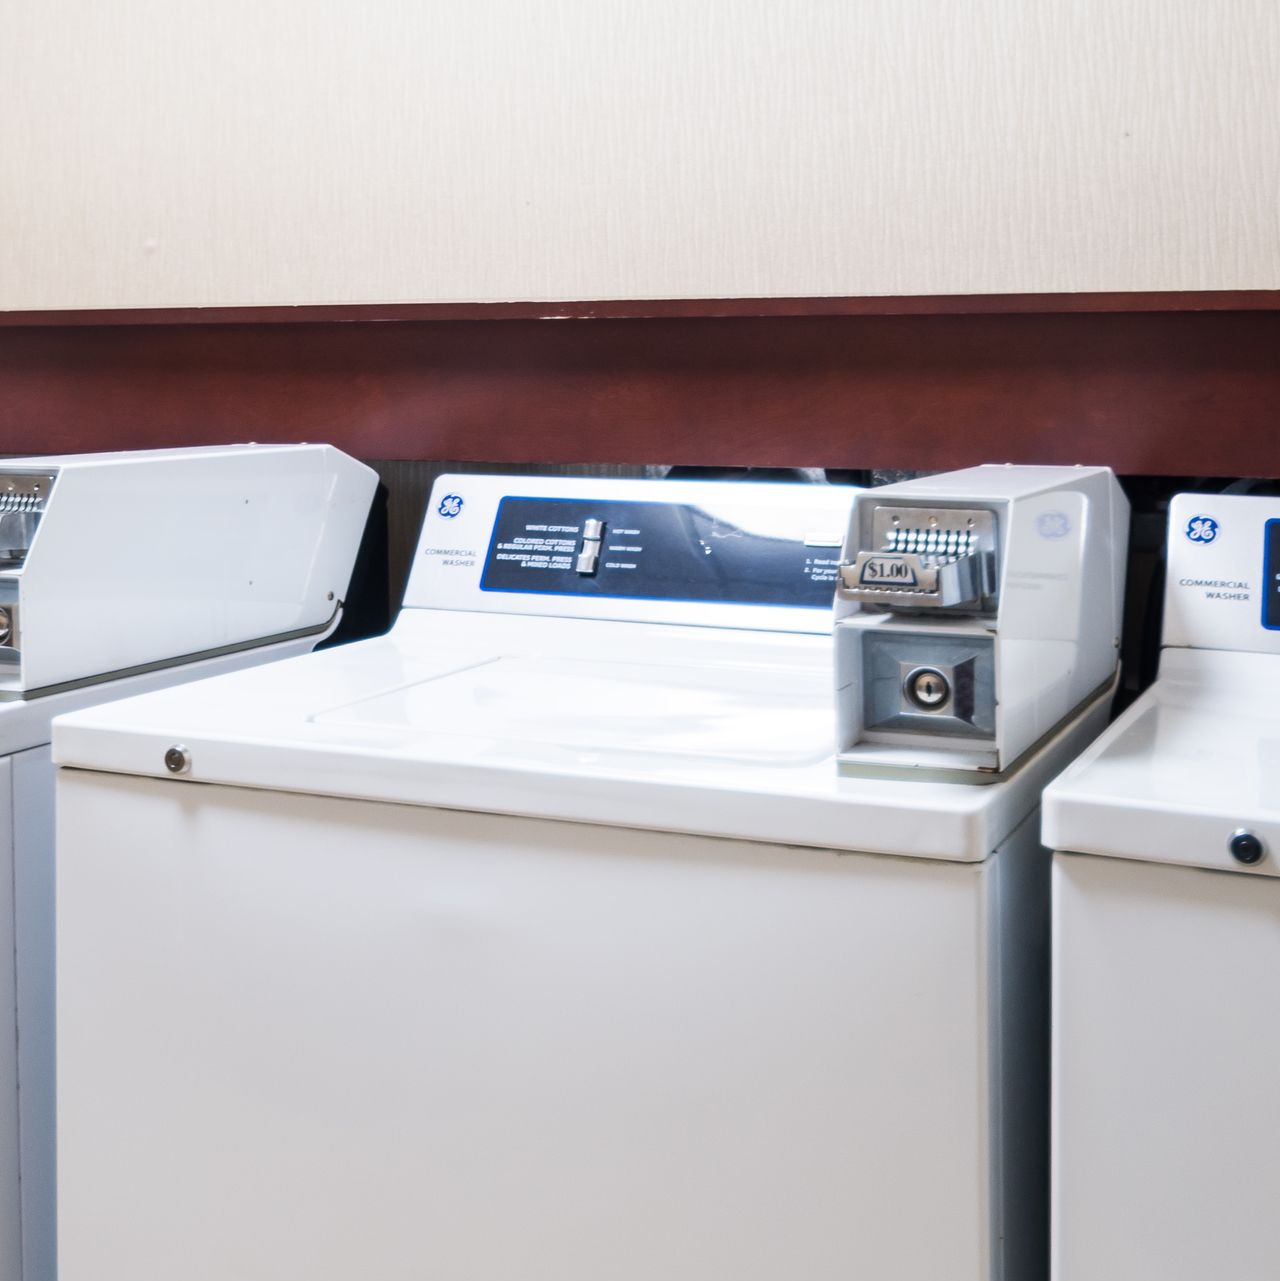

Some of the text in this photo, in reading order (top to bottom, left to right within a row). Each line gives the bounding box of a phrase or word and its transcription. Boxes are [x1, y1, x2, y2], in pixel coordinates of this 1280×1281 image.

[425, 548, 476, 557] COMMERCIAL
[868, 563, 908, 578] $1.00
[1179, 579, 1250, 590] COMMERCIAL
[1205, 592, 1250, 601] WASHER
